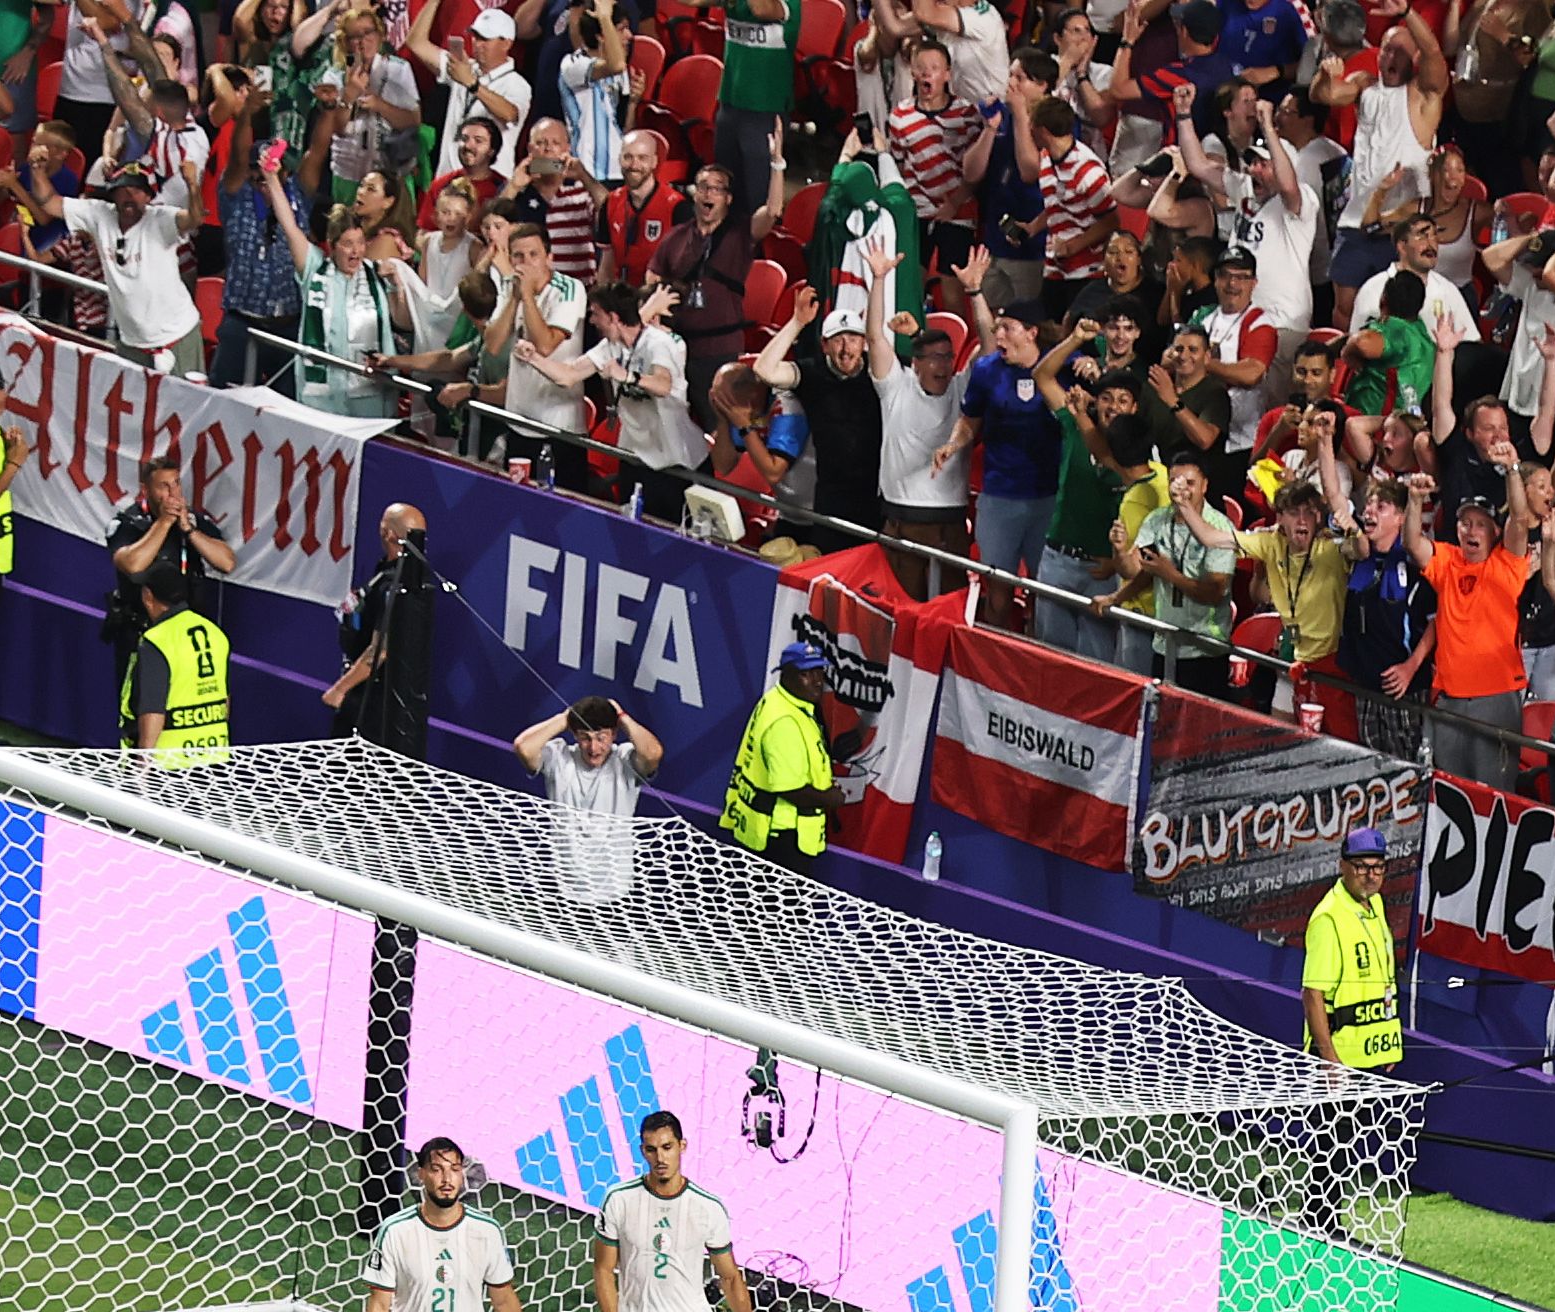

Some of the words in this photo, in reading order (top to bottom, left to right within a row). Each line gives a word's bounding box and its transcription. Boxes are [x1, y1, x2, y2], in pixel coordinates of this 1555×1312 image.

[504, 533, 704, 709] FIFA
[172, 703, 226, 727] SECUR
[987, 711, 1095, 771] EIBISWALD
[1141, 770, 1423, 882] BLUTGRUPPE
[1255, 873, 1284, 892] DAYS
[653, 1252, 669, 1280] 2
